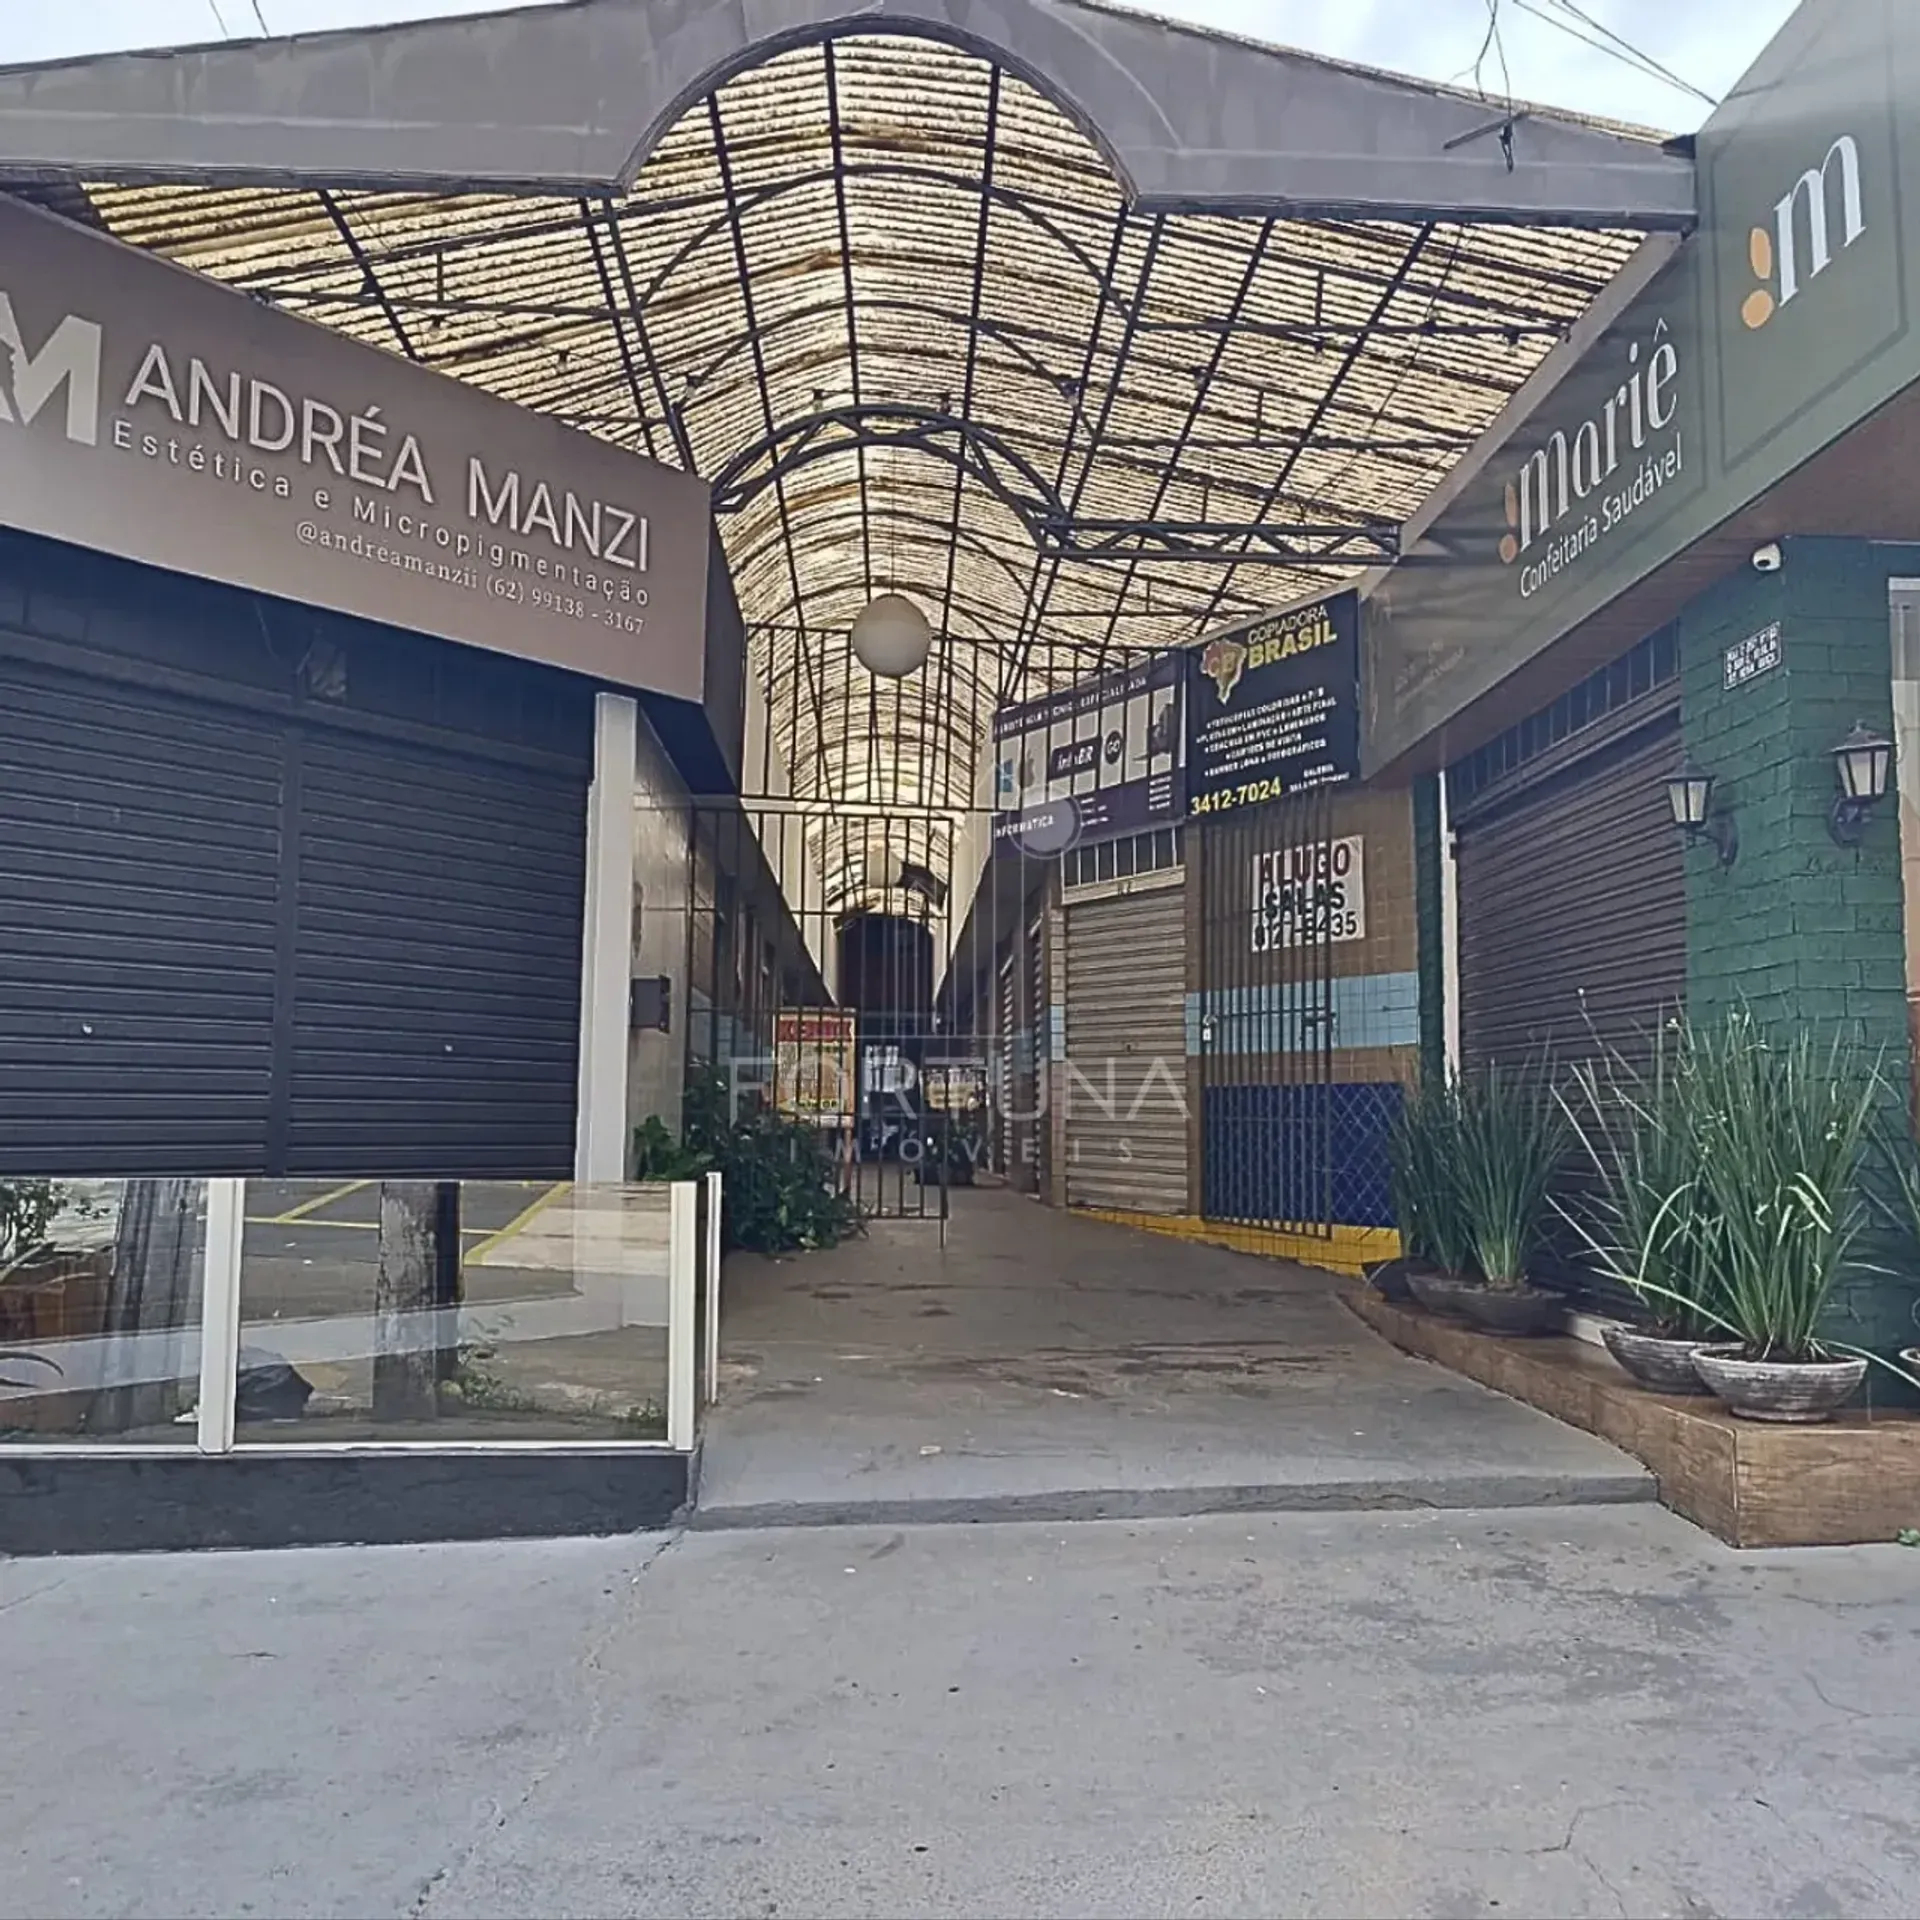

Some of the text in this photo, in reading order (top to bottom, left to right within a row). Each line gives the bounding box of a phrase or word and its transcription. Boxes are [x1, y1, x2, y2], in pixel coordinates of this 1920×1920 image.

[0, 291, 101, 446] M
[1520, 317, 1677, 552] mariê
[113, 420, 649, 606] Estética e Micropigmentação
[125, 344, 648, 572] ANDRÉA MANZI
[1520, 432, 1682, 598] Confeitaria Saudável
[486, 574, 523, 604] (62)
[532, 588, 584, 619] 99138
[604, 610, 645, 635] 3167
[1248, 604, 1329, 644] COPIADORA
[1248, 620, 1338, 669] BRASIL
[1190, 776, 1282, 816] 3412-7024
